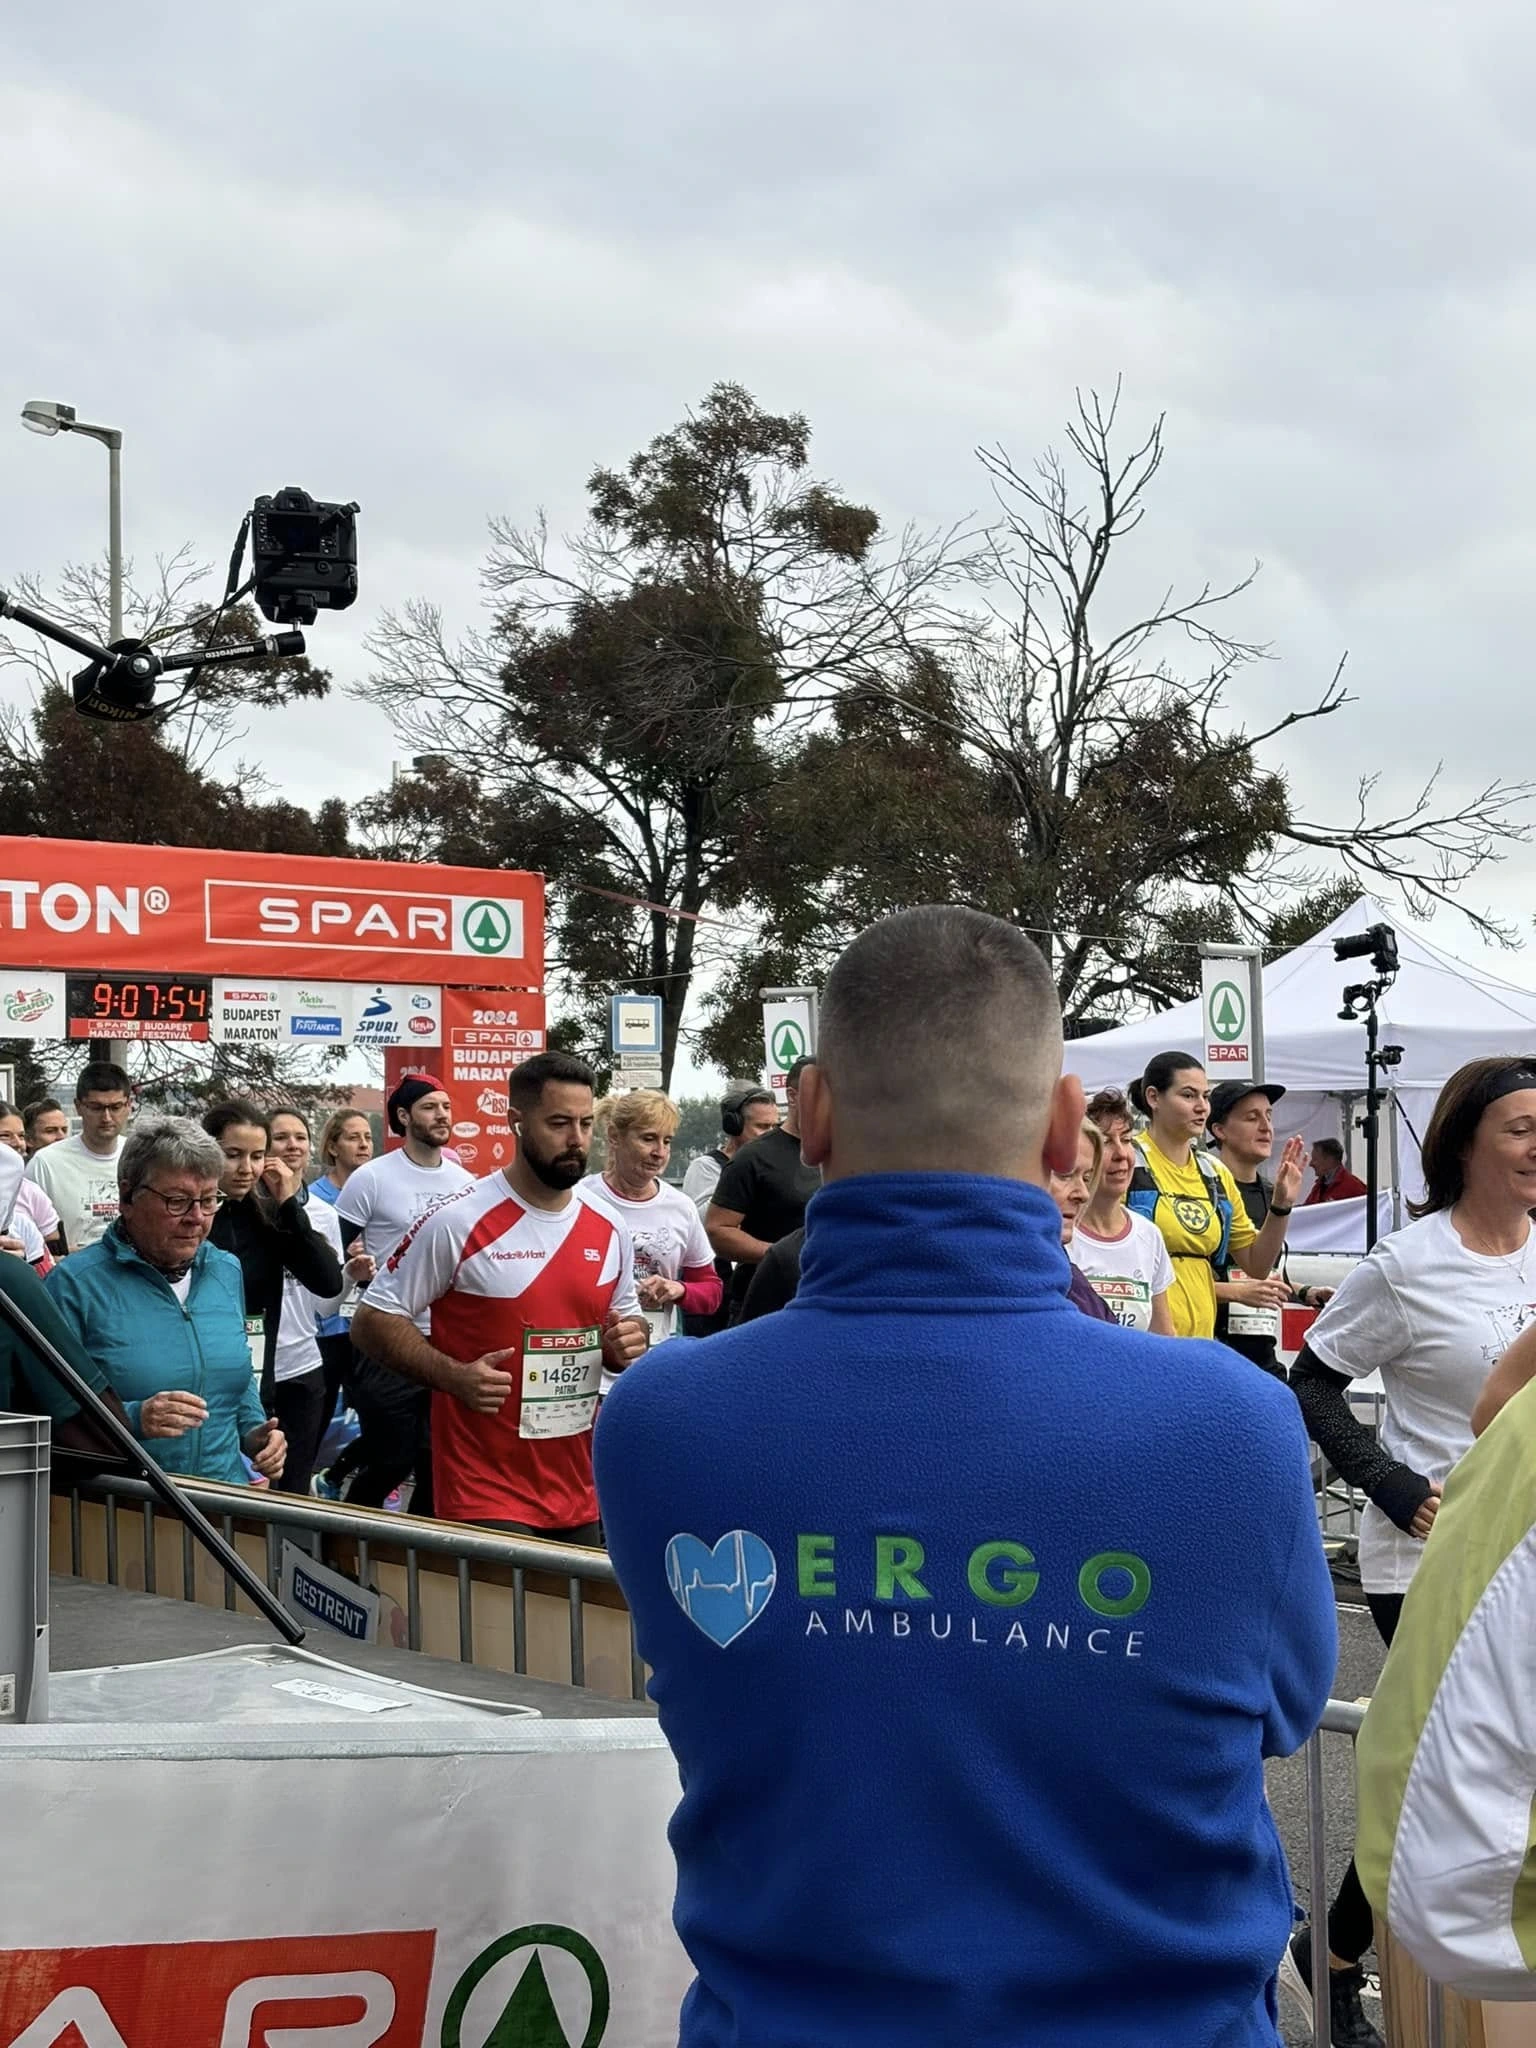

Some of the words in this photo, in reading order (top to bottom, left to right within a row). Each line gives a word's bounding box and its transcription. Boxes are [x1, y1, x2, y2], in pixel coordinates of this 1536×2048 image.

[0, 879, 170, 935] TON®
[259, 897, 448, 941] SPAR
[94, 983, 206, 1018] 9:07:54
[231, 992, 268, 1001] SPAR
[223, 1008, 281, 1021] BUDAPEST
[472, 1009, 518, 1026] 2024
[144, 1021, 193, 1031] BUDAPEST
[356, 1021, 399, 1033] SPURI
[465, 1032, 516, 1044] SPAR
[1209, 1047, 1248, 1060] SPAR
[453, 1067, 514, 1081] MARAT
[1092, 1282, 1135, 1295] SPAR
[541, 1335, 585, 1348] SPAR
[529, 1371, 537, 1382] 6
[542, 1366, 590, 1384] 14627
[797, 1533, 1152, 1618] ERGO
[295, 1574, 363, 1635] BESTRENT
[805, 1609, 1145, 1657] AMBULANCE
